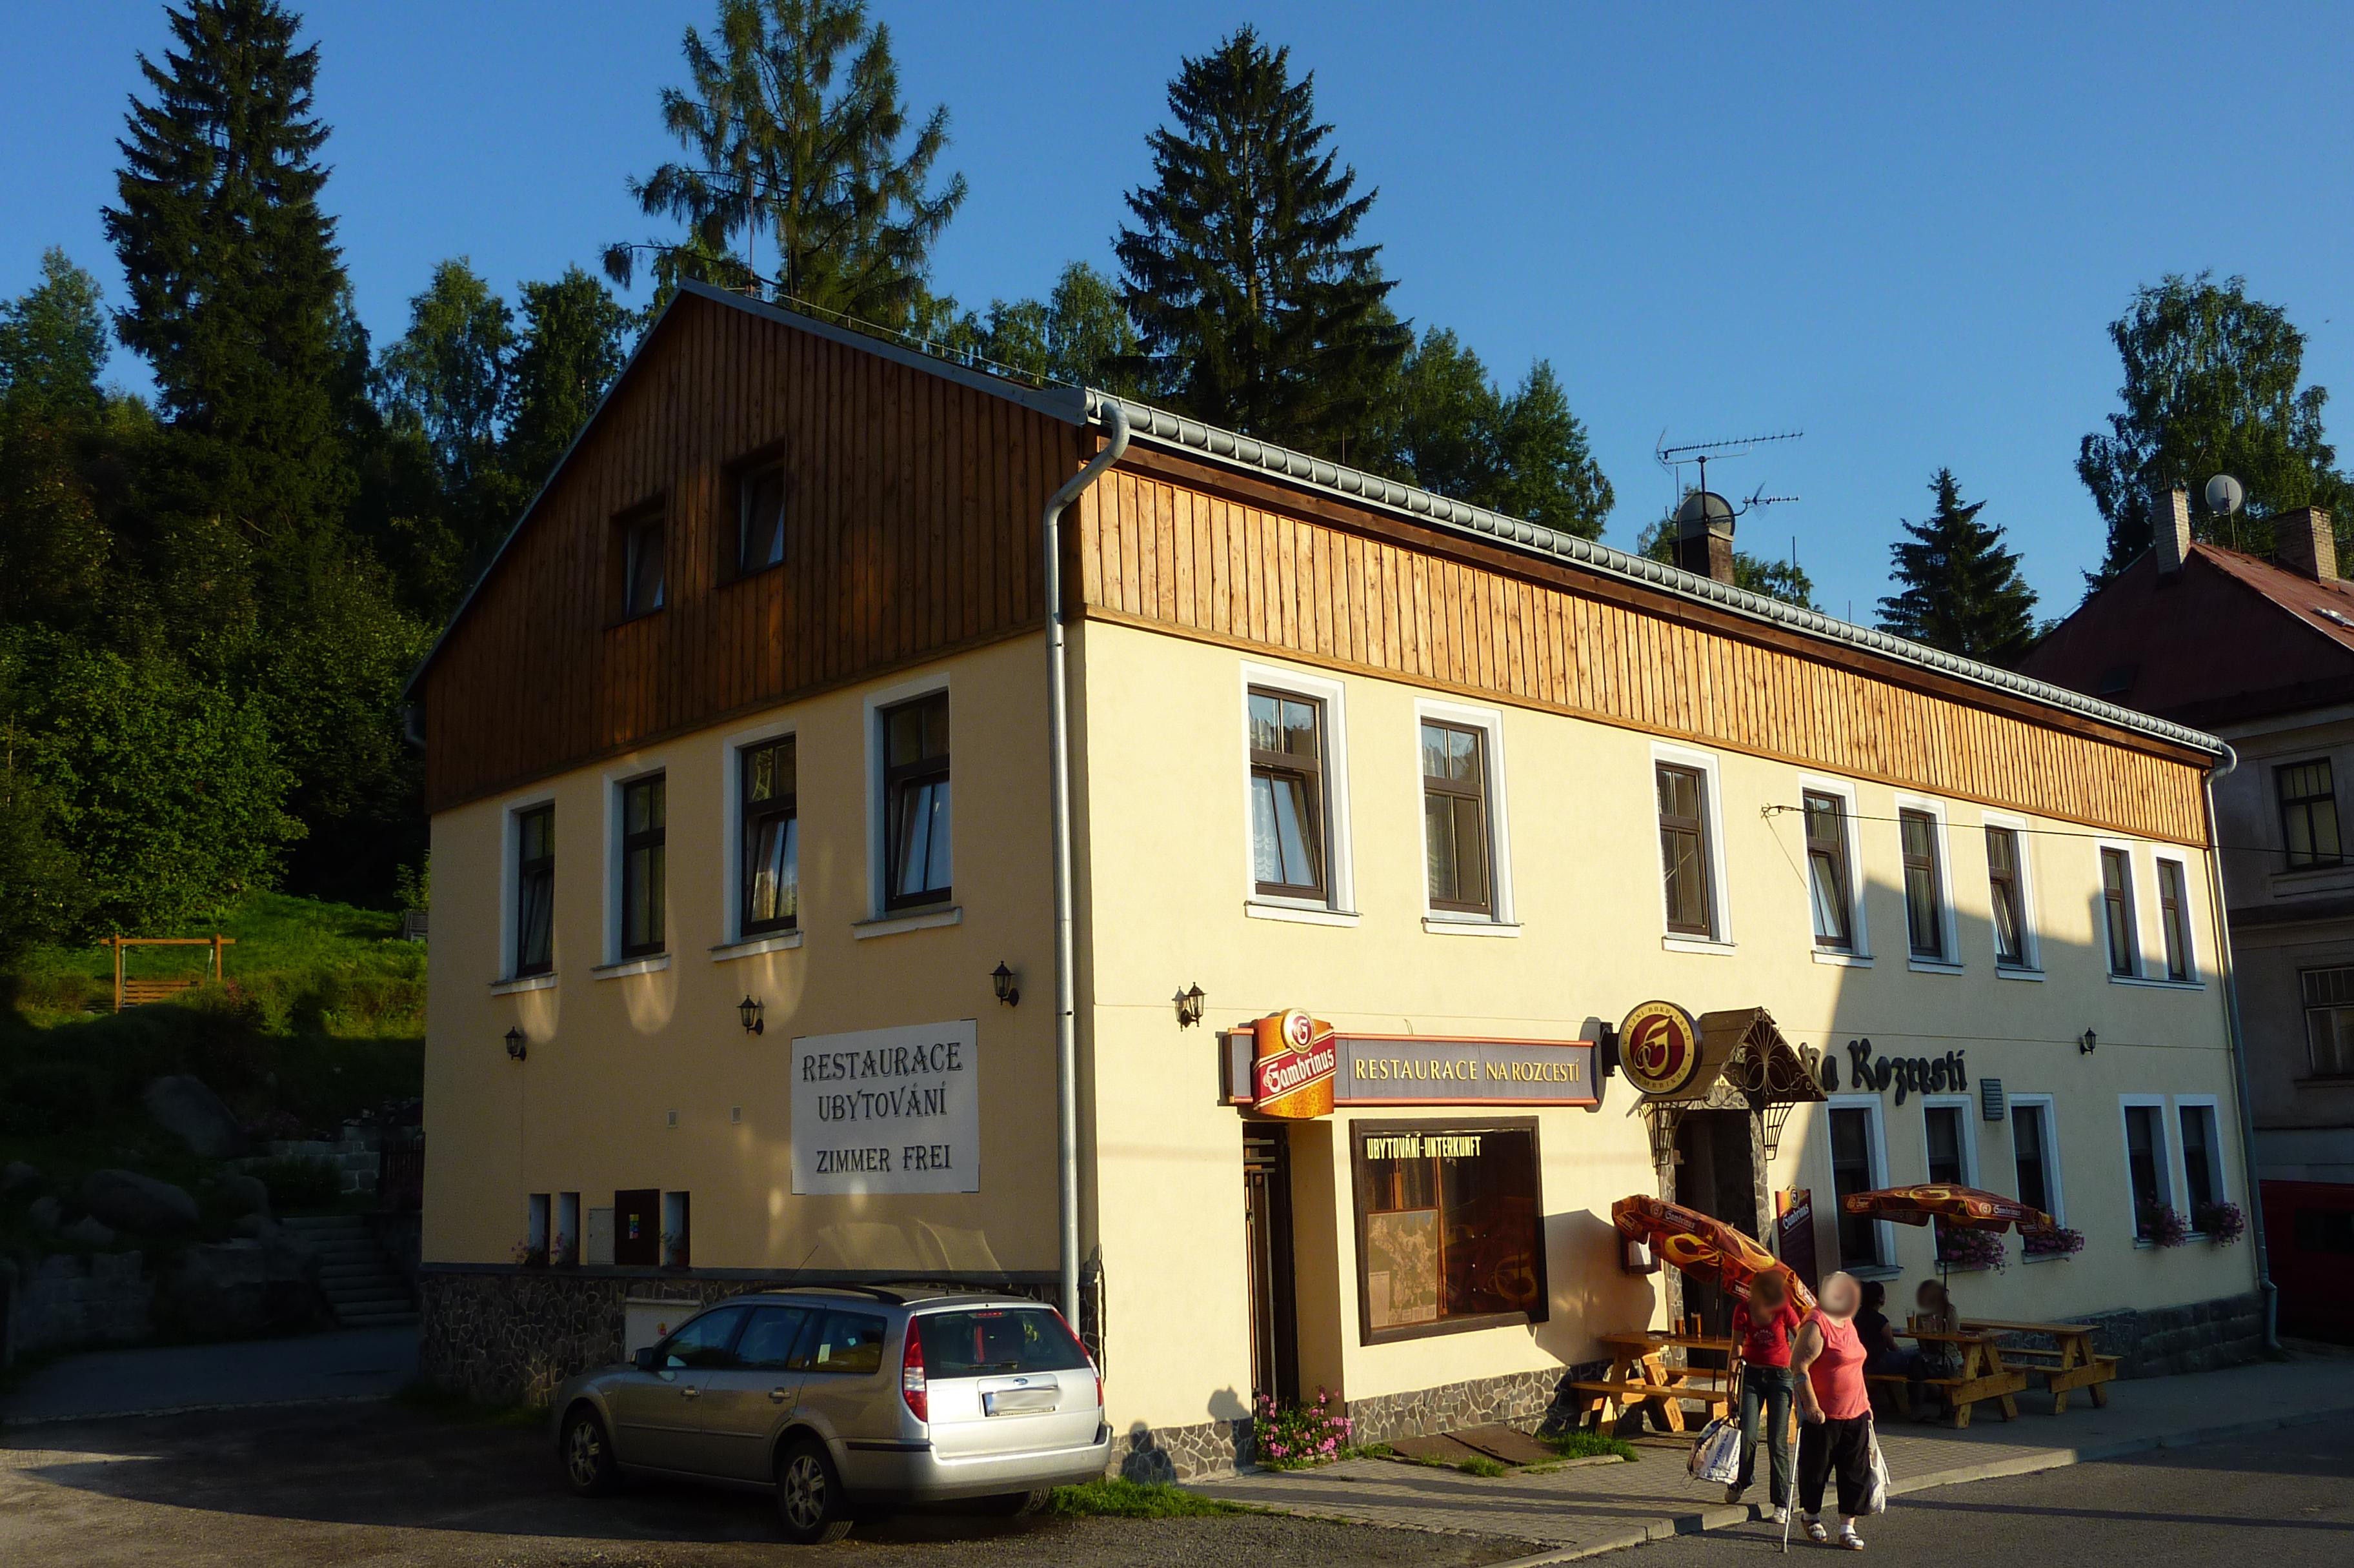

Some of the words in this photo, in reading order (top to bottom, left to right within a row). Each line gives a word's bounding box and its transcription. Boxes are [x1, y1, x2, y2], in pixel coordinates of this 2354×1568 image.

[802, 1042, 963, 1083] RESTAURACE
[1263, 1049, 1334, 1094] Gambrinus
[1355, 1059, 1478, 1080] RESTAURACE
[1485, 1061, 1509, 1081] NA
[1513, 1058, 1580, 1082] ROZCESTÍ
[1847, 1038, 1967, 1106] Rozcestí
[818, 1081, 947, 1121] UBYTOVÁNÍ
[816, 1148, 890, 1173] ZIMMER
[903, 1144, 952, 1171] FREI
